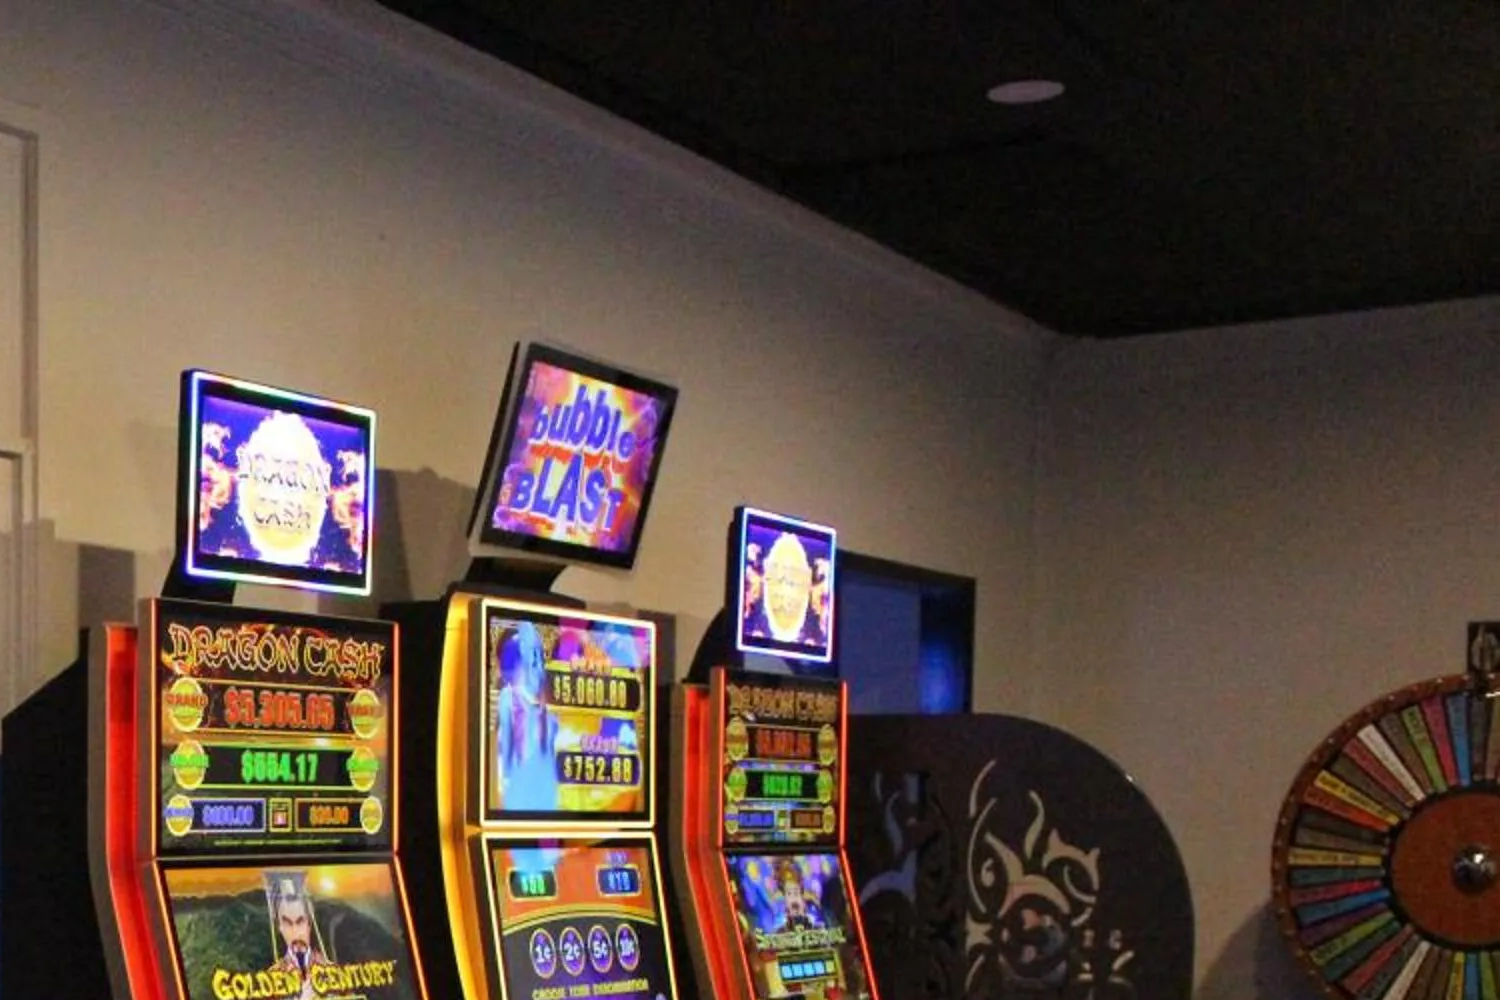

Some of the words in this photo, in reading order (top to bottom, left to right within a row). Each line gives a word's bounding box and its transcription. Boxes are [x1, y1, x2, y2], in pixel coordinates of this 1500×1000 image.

[531, 384, 636, 459] bubble
[512, 453, 624, 528] BLAST
[168, 622, 299, 674] DRAGON
[303, 637, 381, 680] CASH
[310, 961, 394, 994] CENTURY
